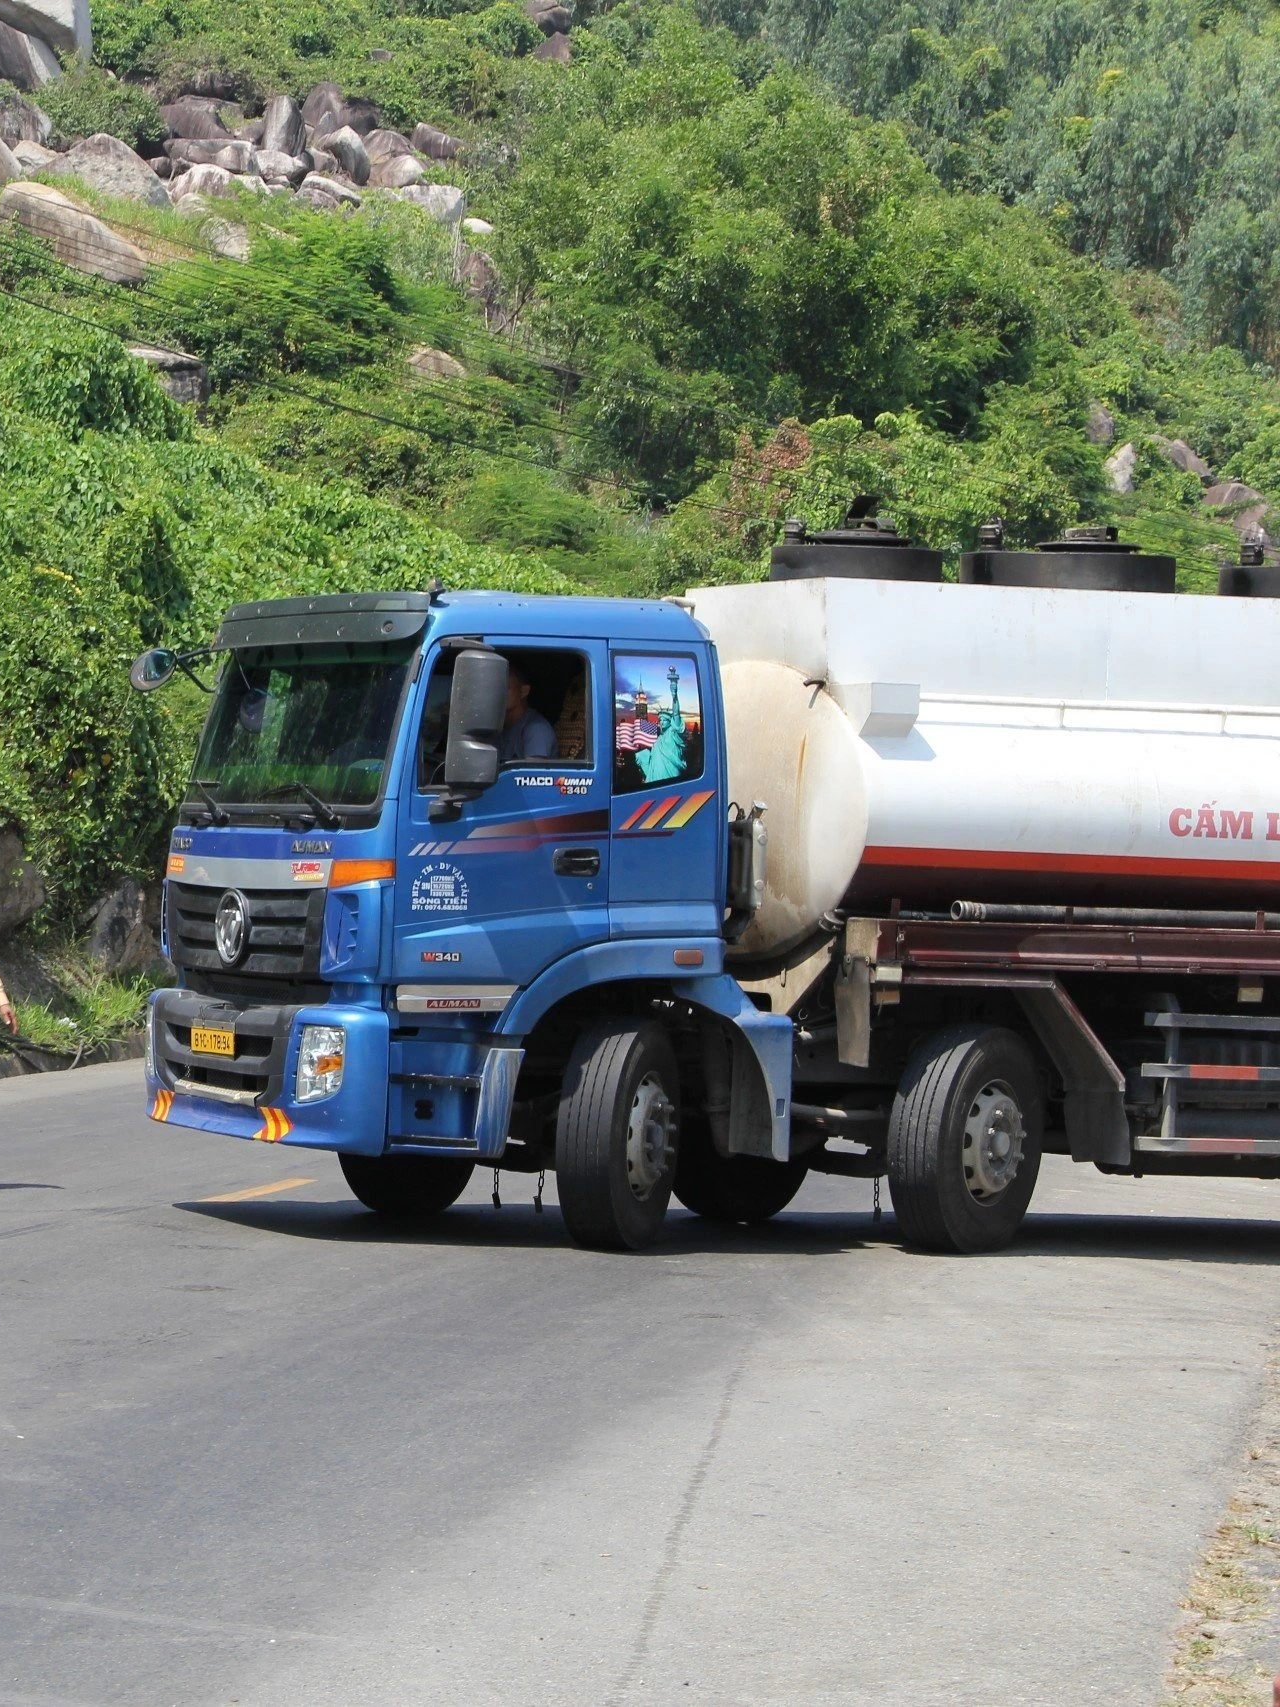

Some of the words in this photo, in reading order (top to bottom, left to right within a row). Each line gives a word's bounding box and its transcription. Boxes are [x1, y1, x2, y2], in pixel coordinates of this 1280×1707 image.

[514, 777, 554, 786] THACO
[555, 776, 593, 786] AUMAN
[1168, 800, 1254, 840] CẤM
[412, 879, 421, 897] HTX
[421, 864, 433, 875] TM
[440, 862, 451, 870] DV
[412, 896, 440, 904] SÔNG
[423, 952, 460, 962] W340
[428, 1000, 480, 1008] AUMAN
